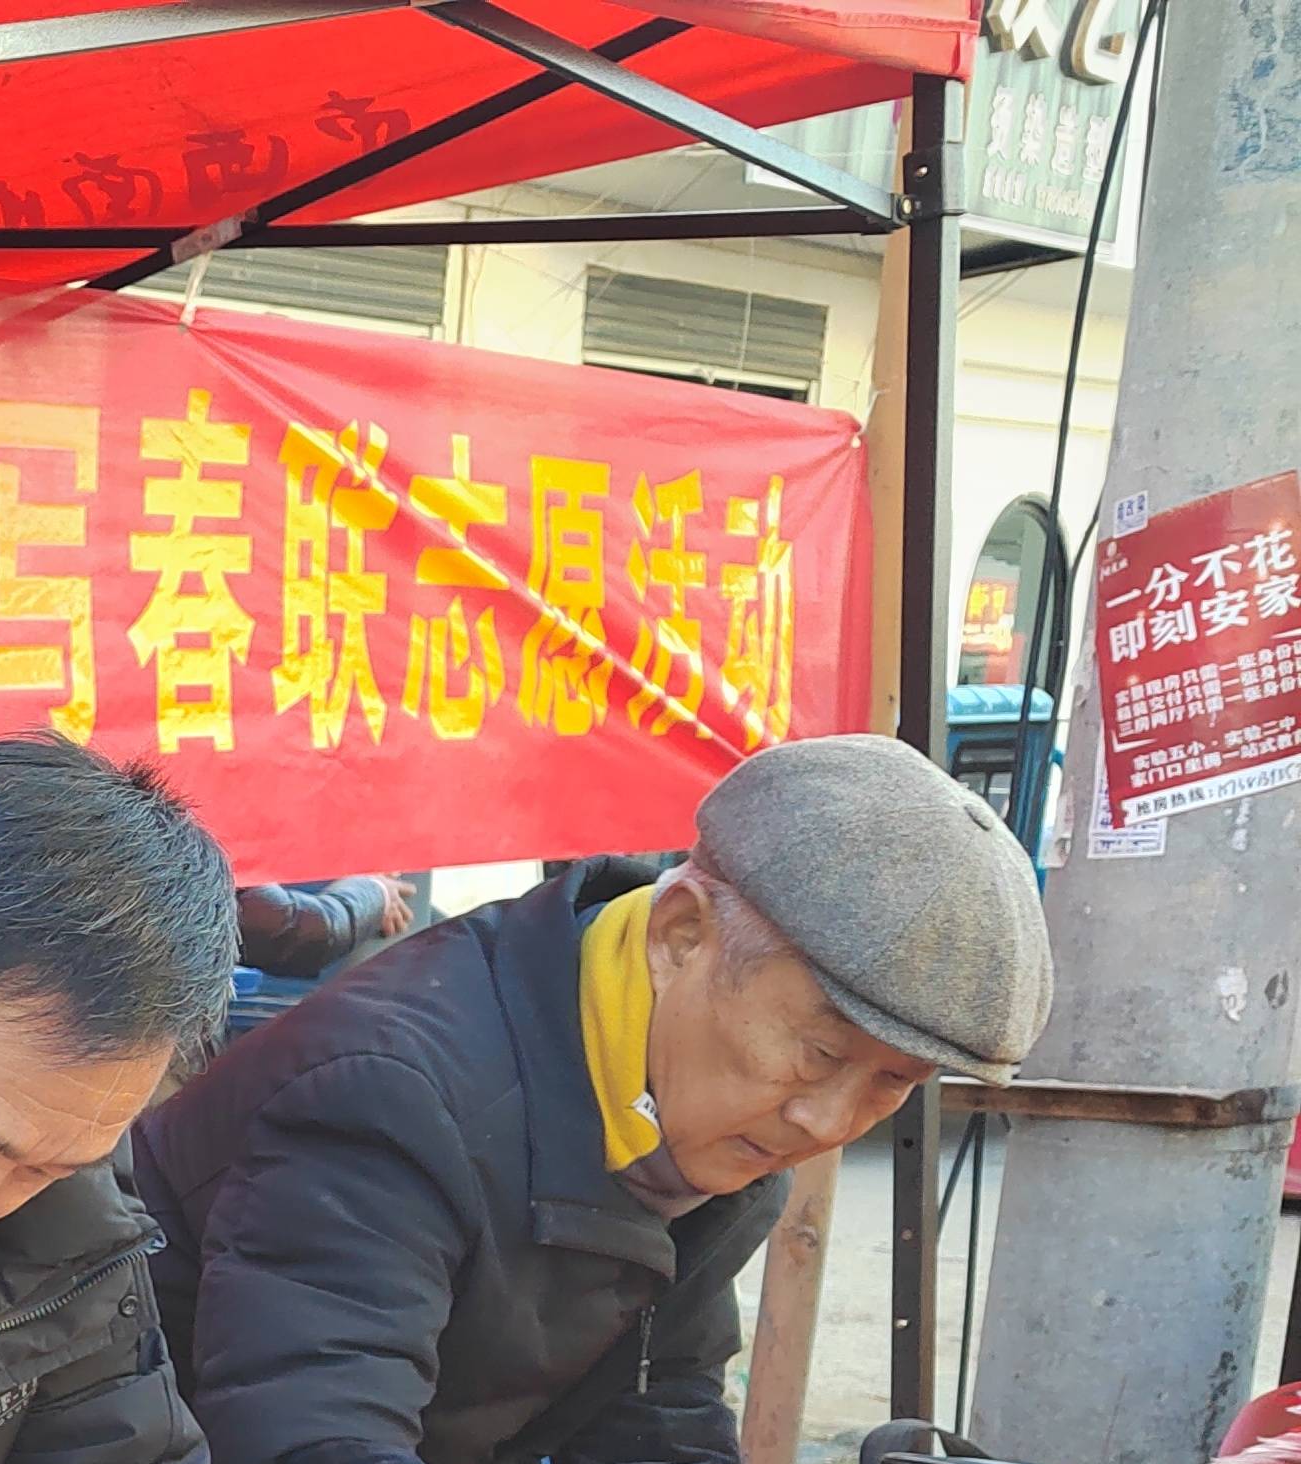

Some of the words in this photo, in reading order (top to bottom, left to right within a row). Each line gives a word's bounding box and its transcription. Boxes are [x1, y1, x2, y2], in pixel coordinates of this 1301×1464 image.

[1105, 528, 1297, 610] 一分不花
[1108, 573, 1301, 663] 即刻安家
[1118, 673, 1301, 738] 三房两厅只需一张身份
